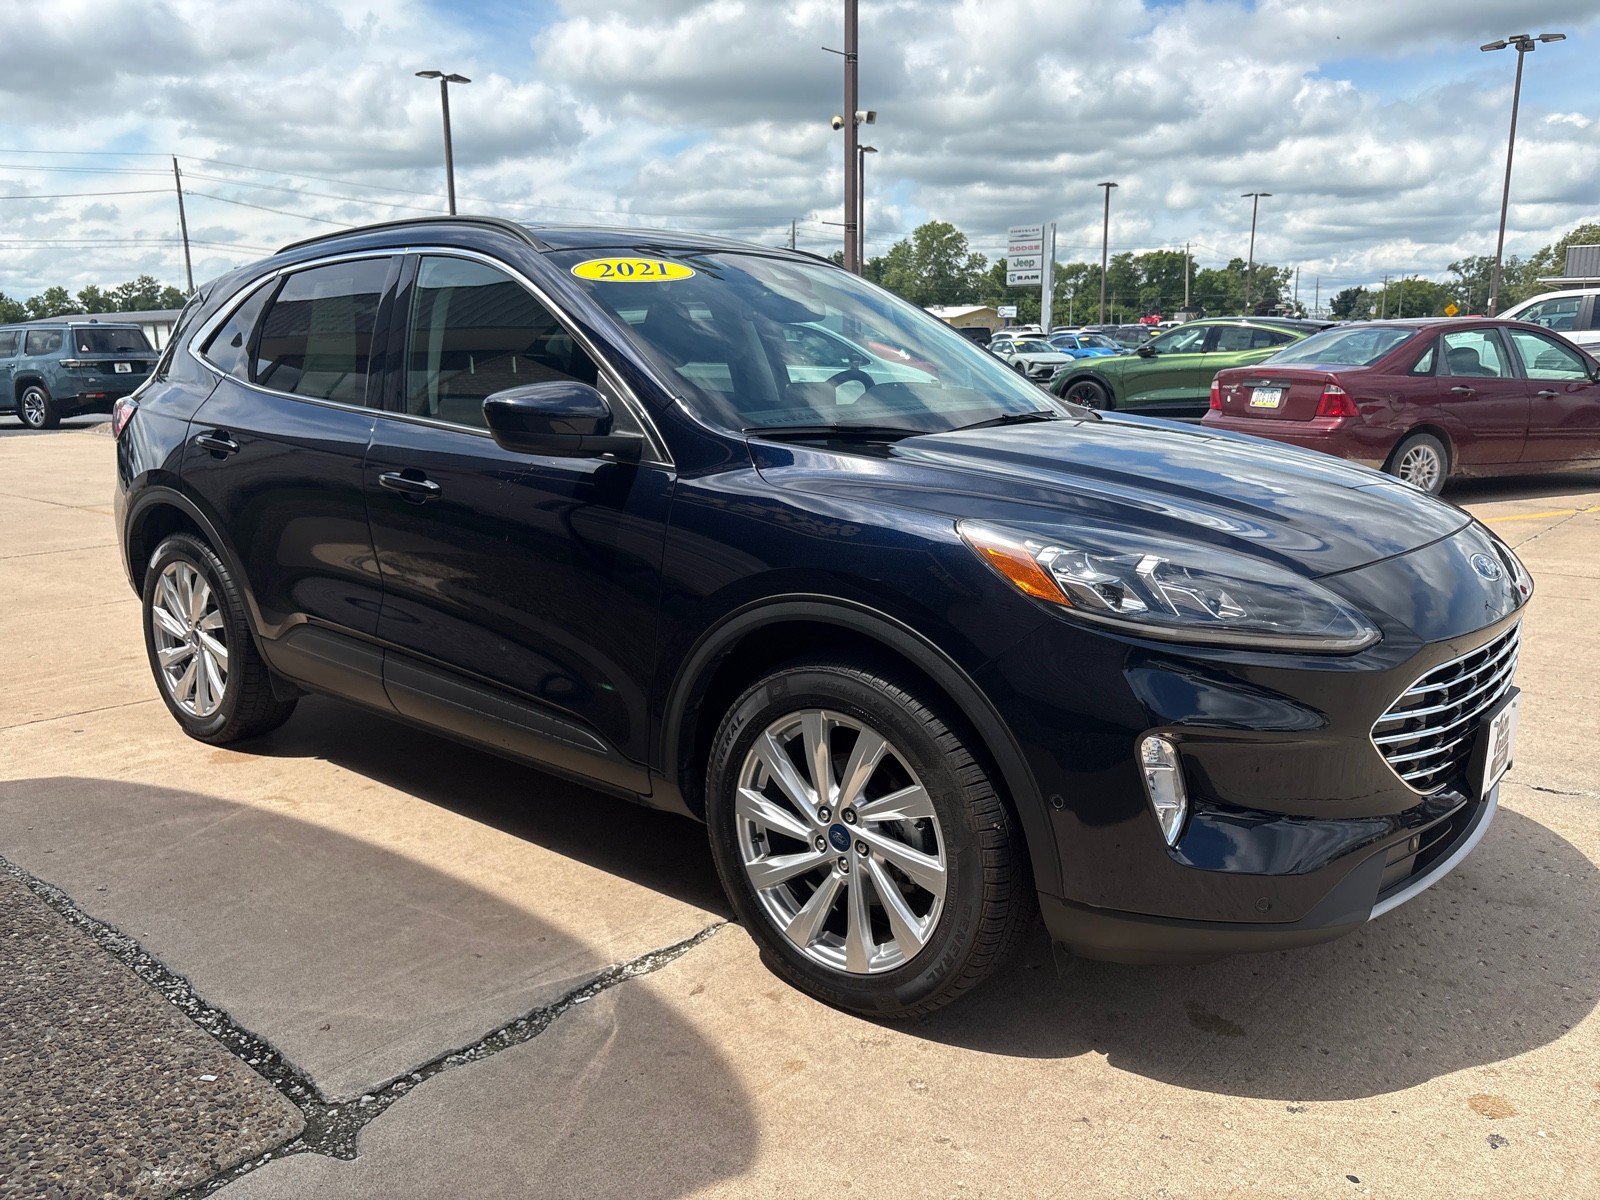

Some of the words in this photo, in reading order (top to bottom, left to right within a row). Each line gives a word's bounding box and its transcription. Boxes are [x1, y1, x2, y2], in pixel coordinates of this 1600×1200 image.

[1009, 244, 1040, 252] DODGE
[1013, 258, 1035, 268] Jeep
[596, 262, 671, 278] 2021
[925, 903, 973, 981] GENERAL
